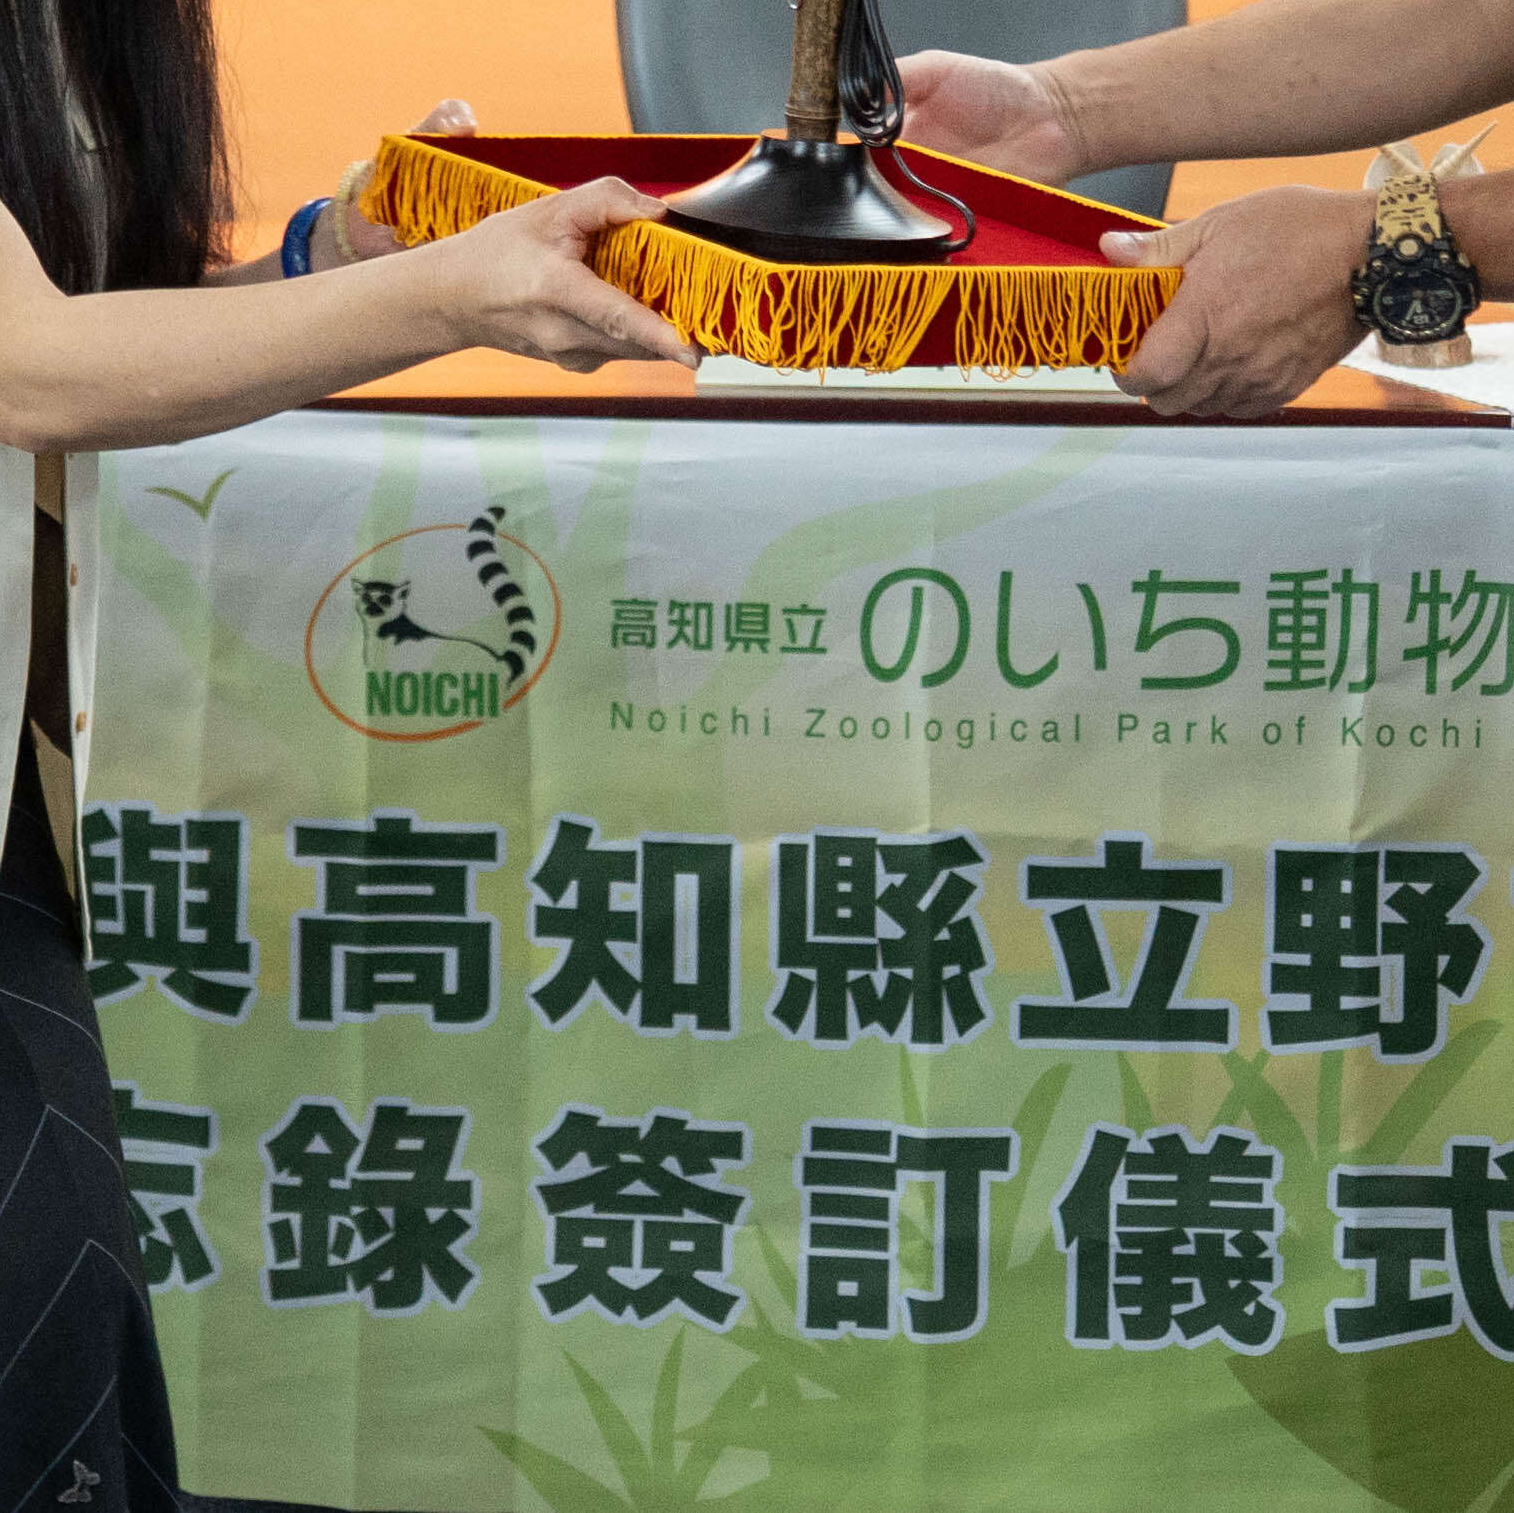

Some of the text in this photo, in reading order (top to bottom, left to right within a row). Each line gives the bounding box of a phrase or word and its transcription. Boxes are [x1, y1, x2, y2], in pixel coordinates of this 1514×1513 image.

[610, 596, 829, 656] 高知県立
[365, 670, 500, 719] NOICHI
[609, 700, 771, 738] Noichi
[802, 706, 1083, 751] Zoological
[1116, 711, 1229, 746] Park
[1260, 714, 1308, 747] of
[1340, 716, 1483, 750] Kochi
